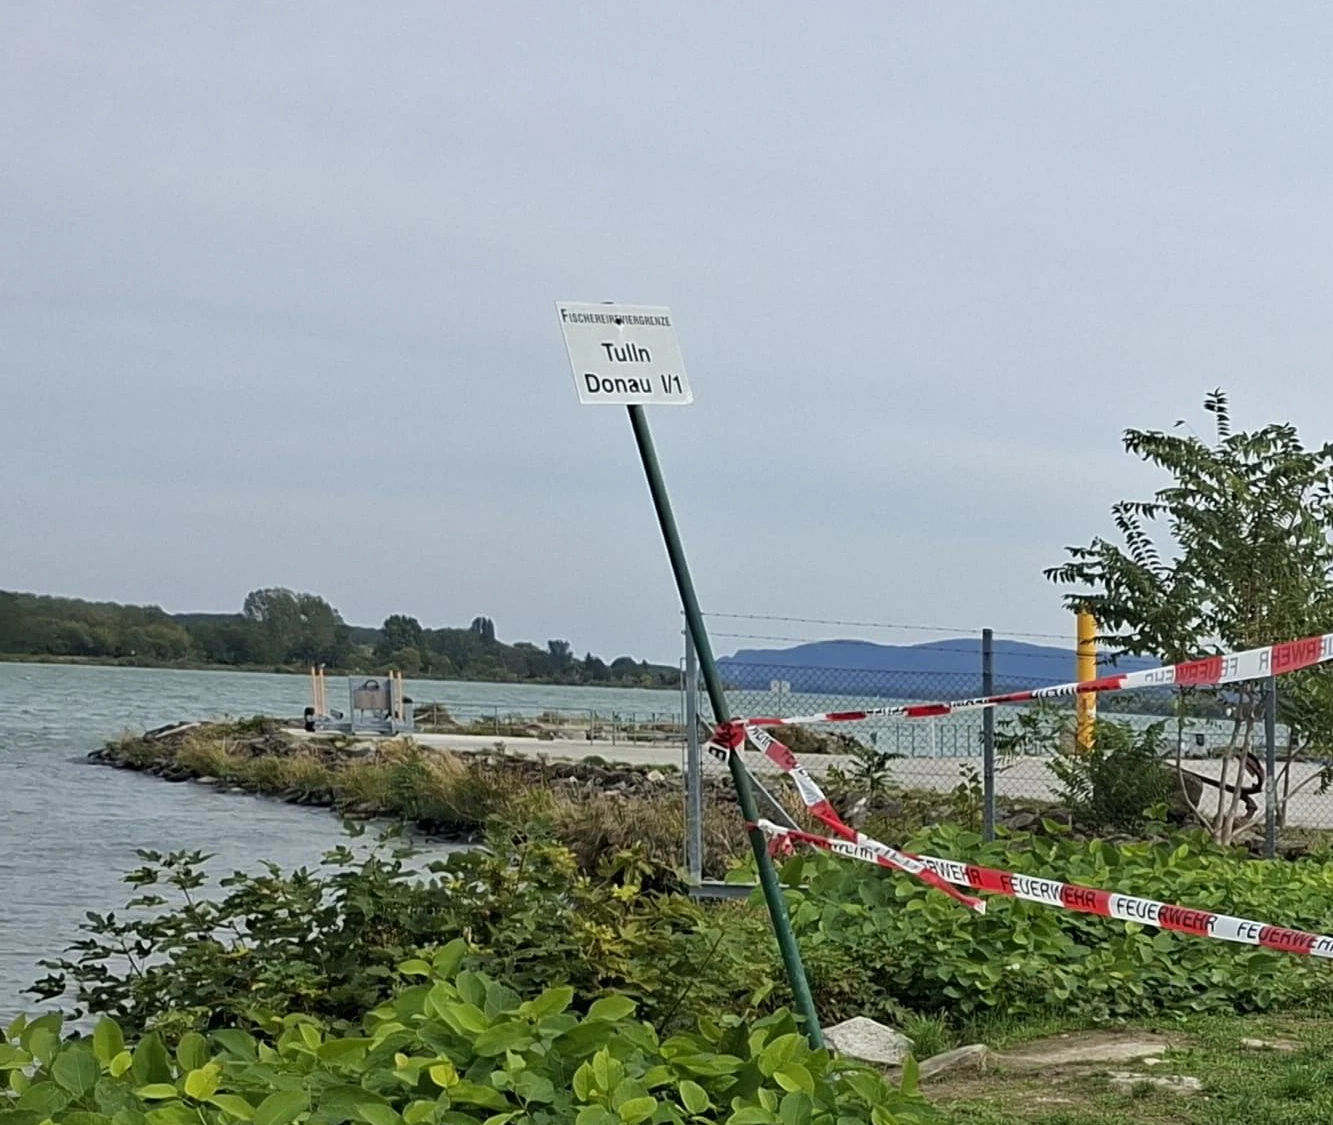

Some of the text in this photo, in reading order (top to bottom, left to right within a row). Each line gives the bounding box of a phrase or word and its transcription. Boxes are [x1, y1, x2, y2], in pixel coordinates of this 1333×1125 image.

[601, 343, 651, 362] Tulln
[584, 374, 652, 393] Donau
[1001, 874, 1097, 909] FEUERWEHR
[1116, 897, 1218, 932] FEUERWEHR
